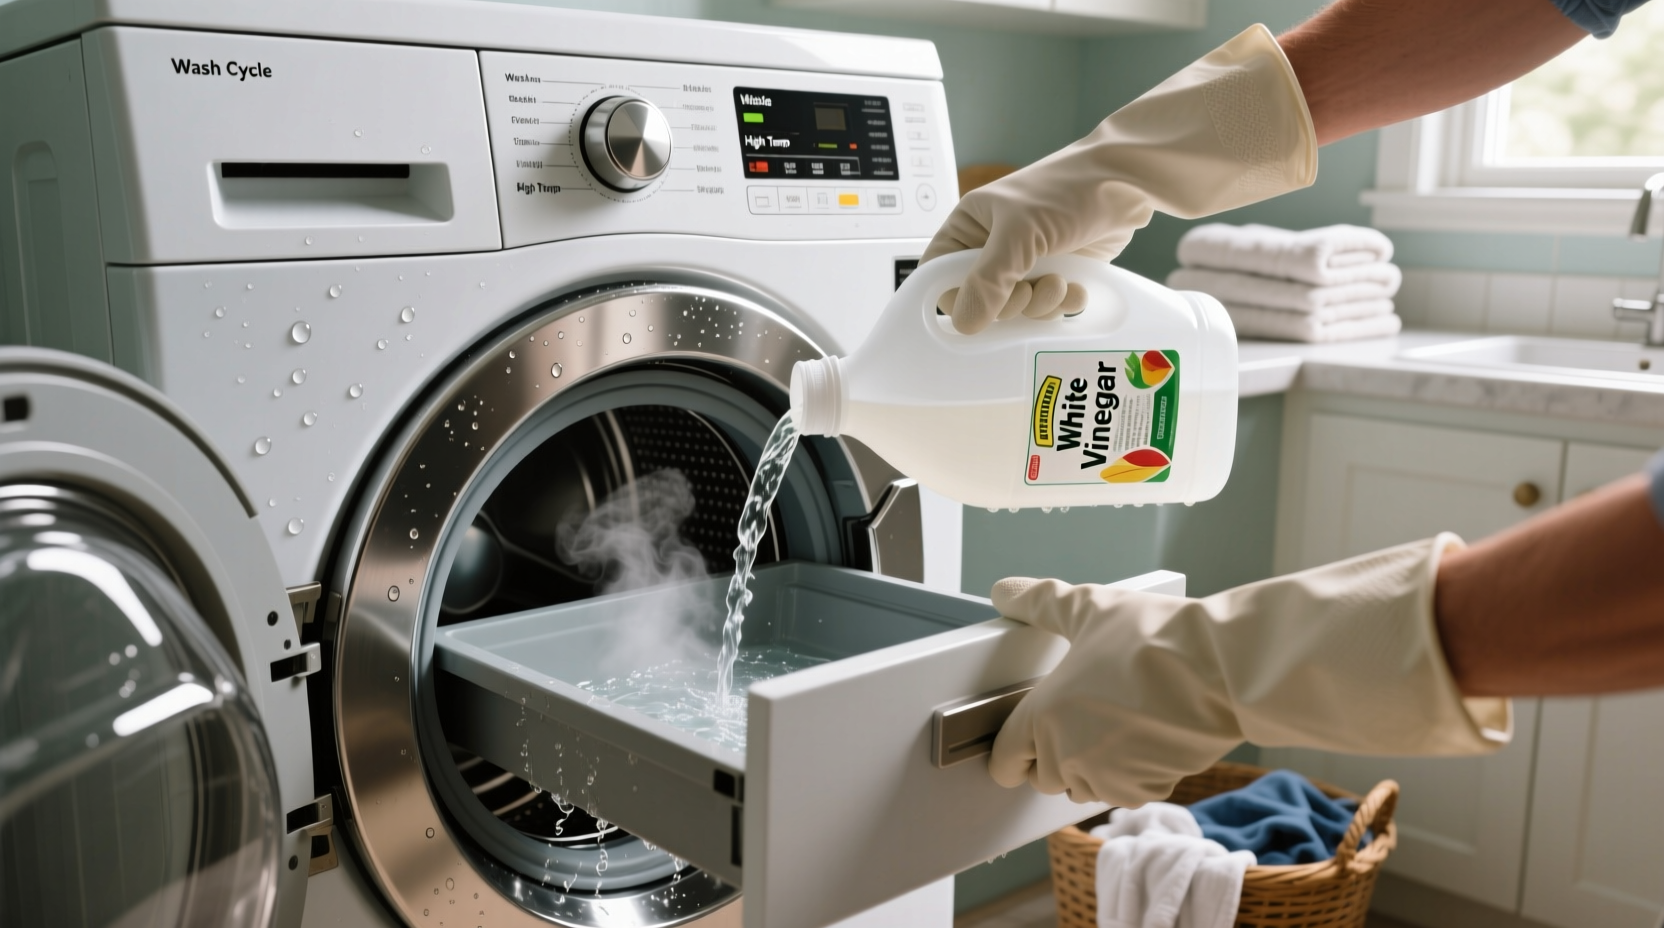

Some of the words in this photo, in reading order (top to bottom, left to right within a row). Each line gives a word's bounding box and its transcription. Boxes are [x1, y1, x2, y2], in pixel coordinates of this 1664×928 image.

[170, 57, 222, 76] Wash
[226, 60, 273, 82] Cycle
[1056, 377, 1088, 452] White
[1080, 360, 1120, 470] Vinegar
